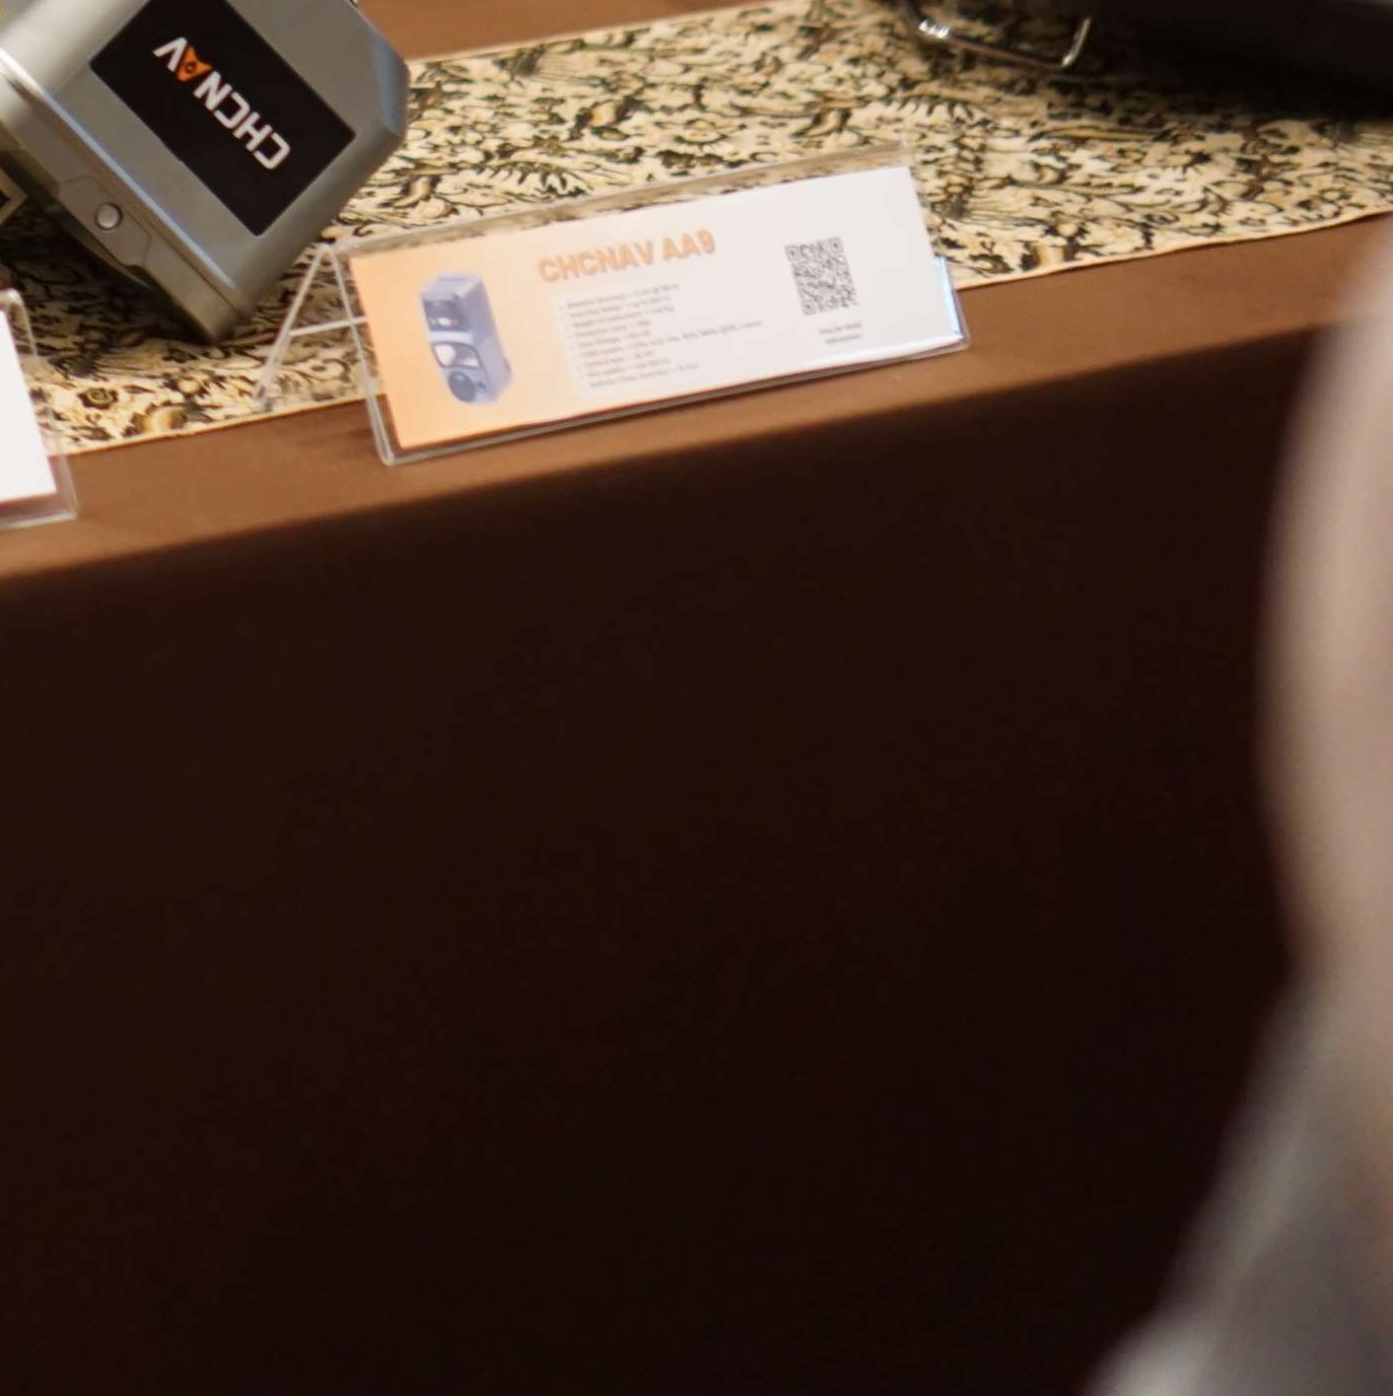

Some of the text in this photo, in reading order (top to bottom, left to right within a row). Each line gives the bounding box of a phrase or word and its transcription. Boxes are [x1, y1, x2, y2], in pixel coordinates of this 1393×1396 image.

[153, 37, 290, 169] CHCNAV
[538, 228, 716, 283] CHCNAV AA9
